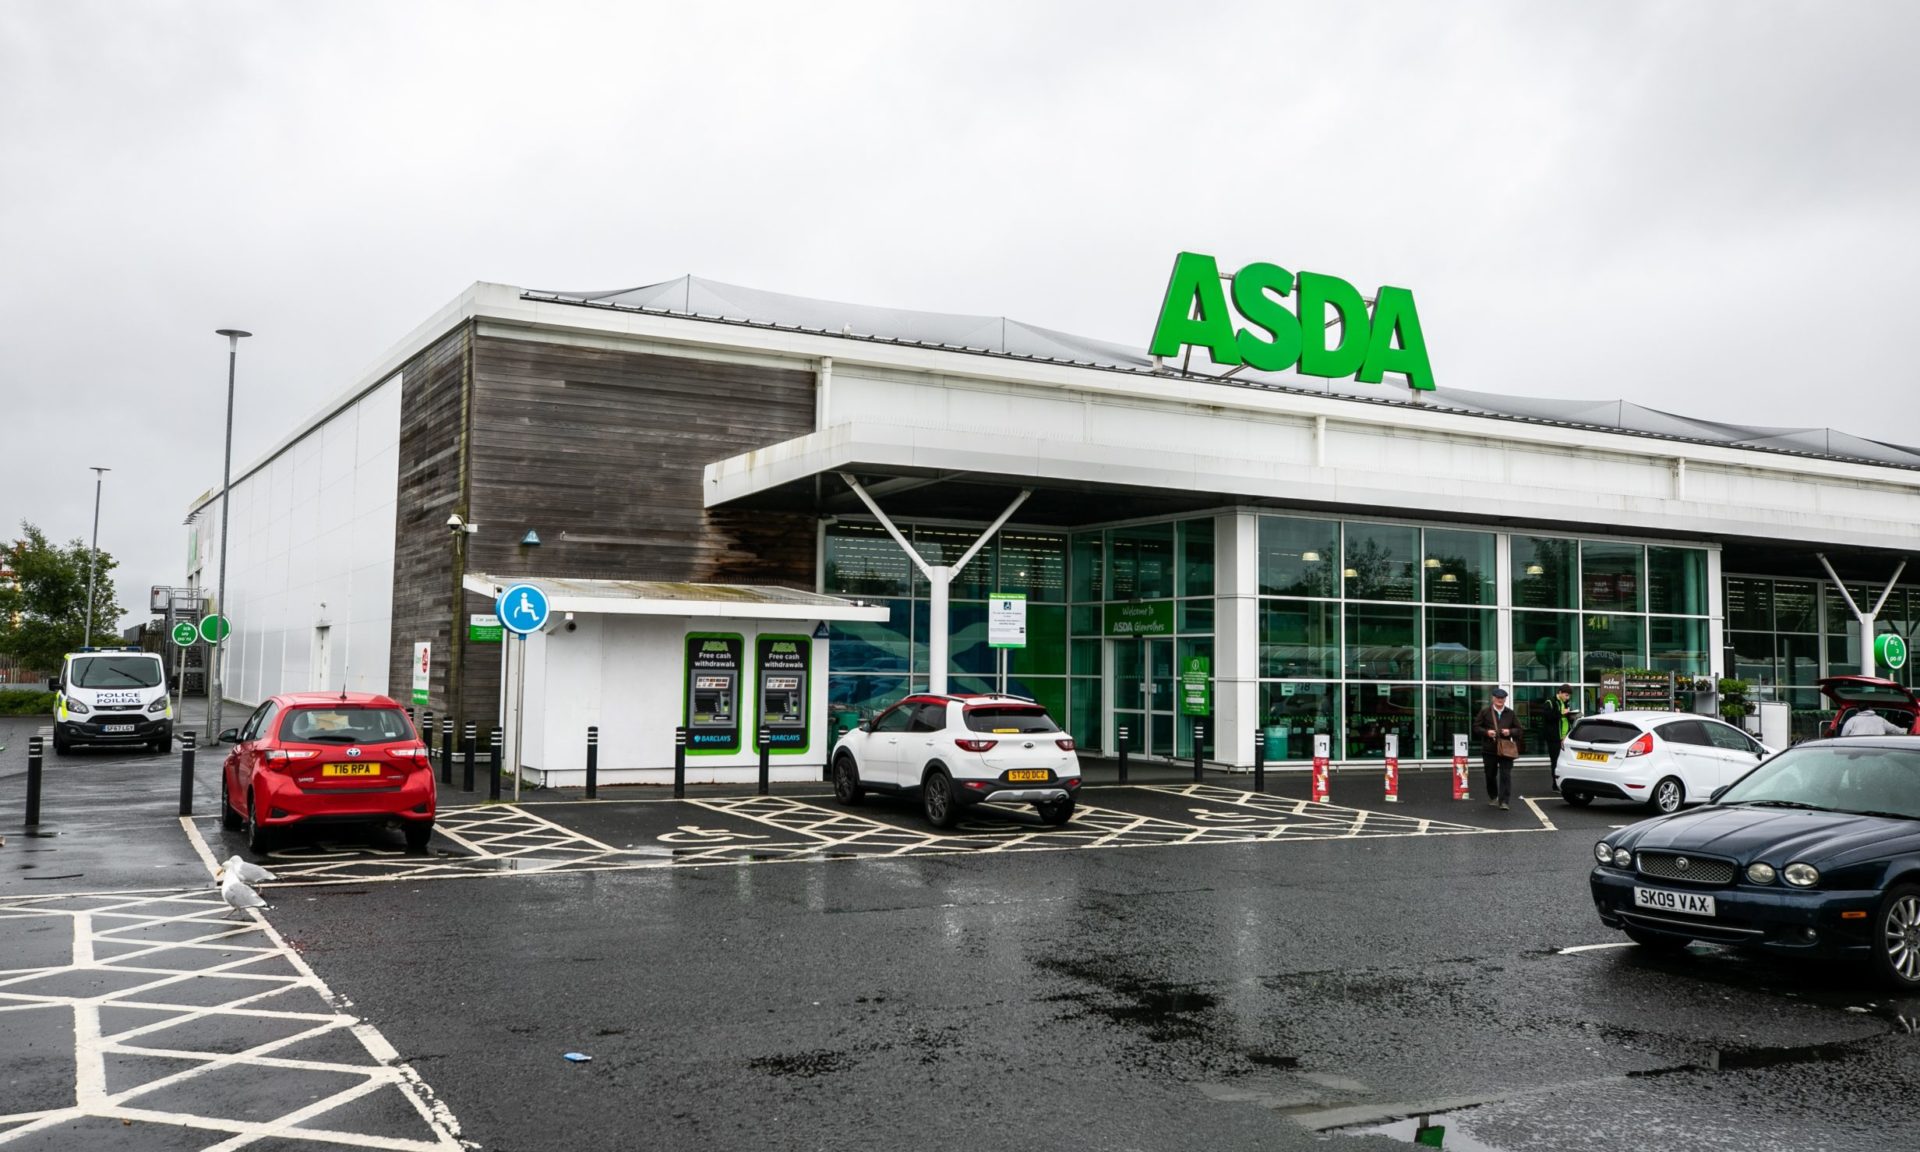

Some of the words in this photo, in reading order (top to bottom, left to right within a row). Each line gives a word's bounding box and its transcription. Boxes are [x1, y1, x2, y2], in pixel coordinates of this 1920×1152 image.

[1148, 251, 1436, 391] ASDA
[1113, 622, 1133, 632] ASDA
[333, 764, 348, 774] T16
[351, 764, 371, 774] RPA
[1012, 771, 1030, 779] ST20
[1031, 771, 1045, 779] DCZ
[1640, 889, 1675, 908] SK09
[1678, 894, 1708, 912] VAX
